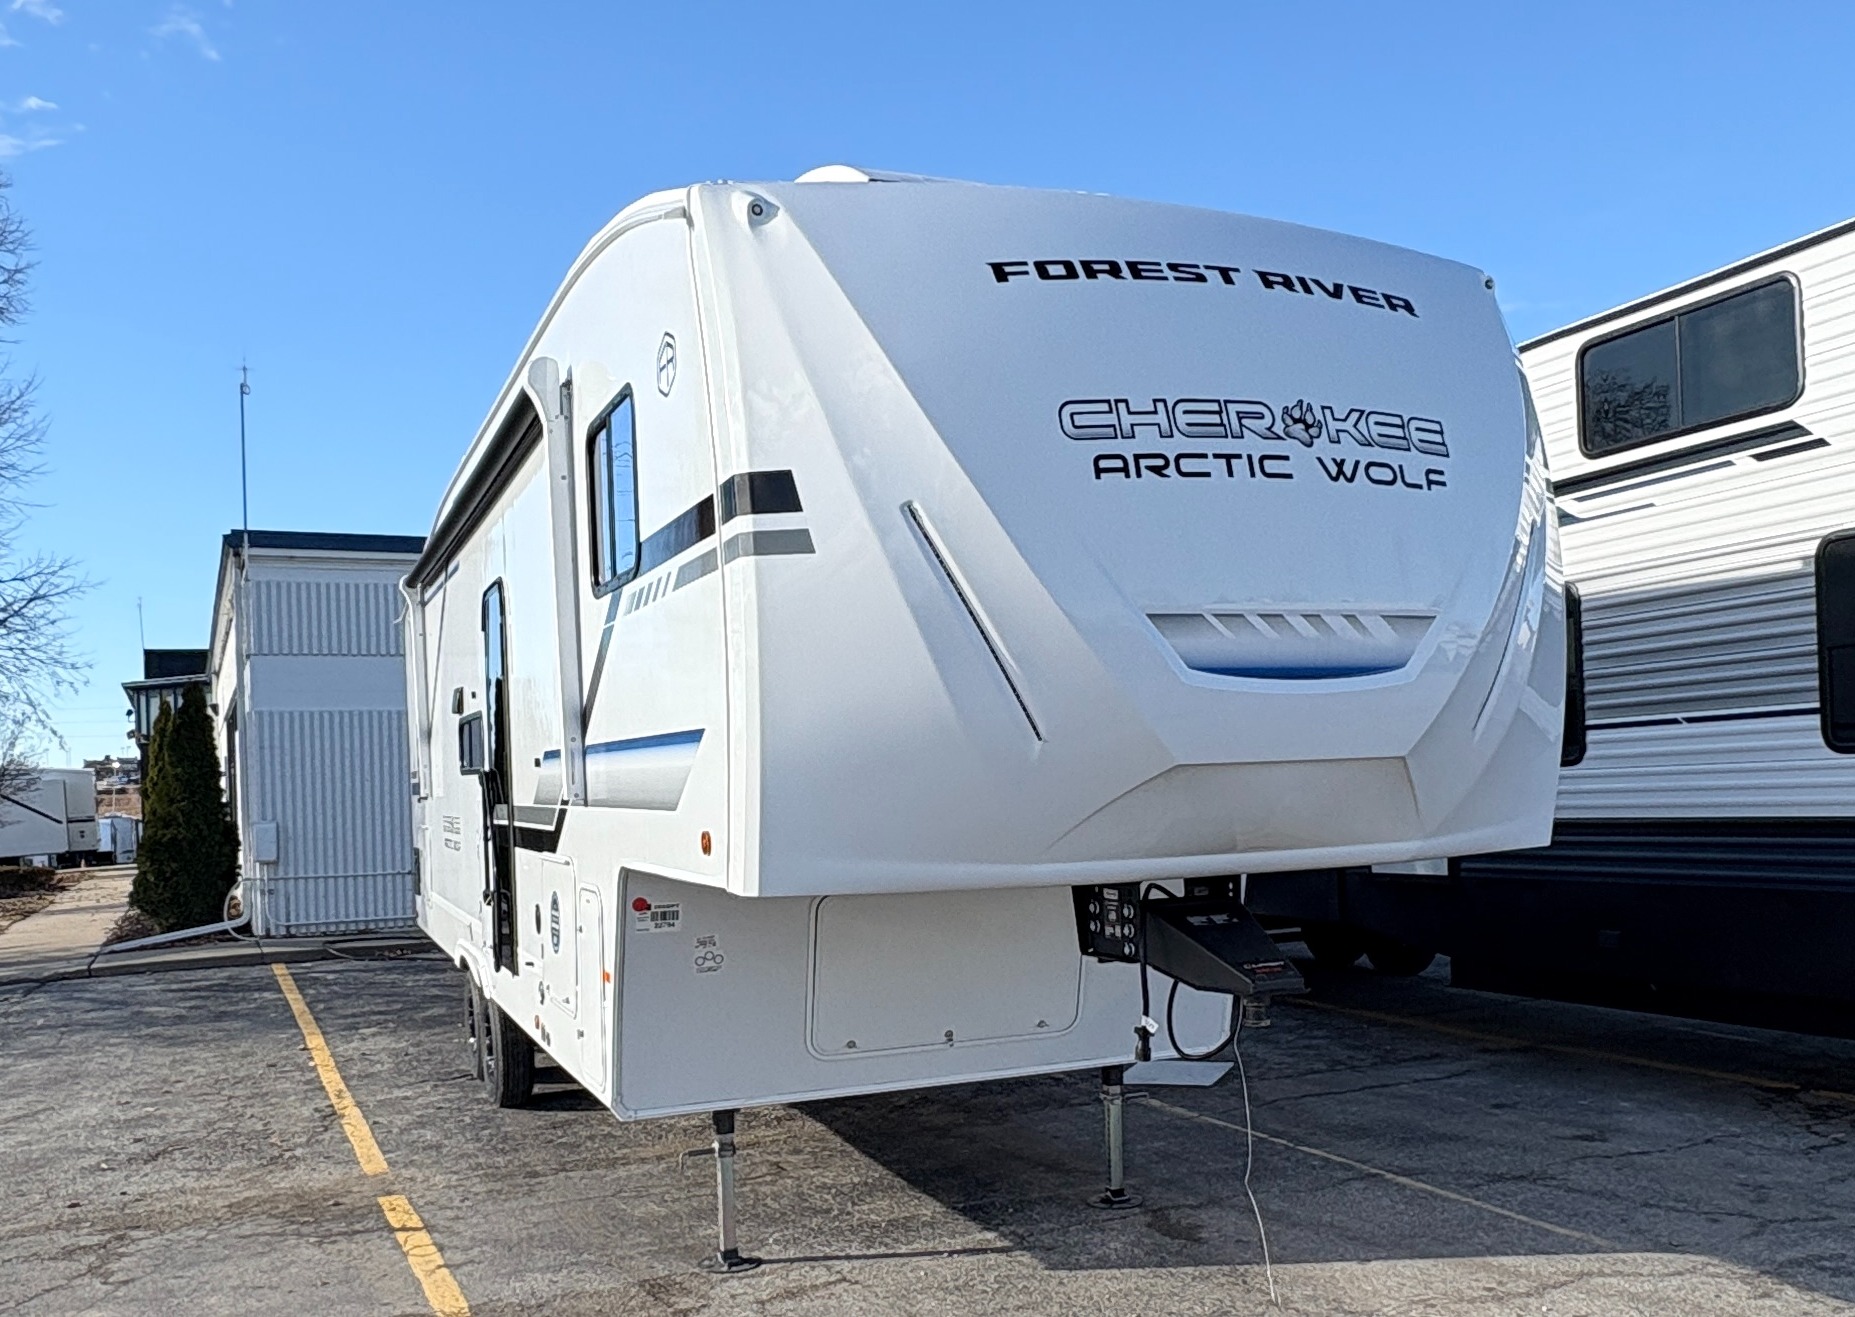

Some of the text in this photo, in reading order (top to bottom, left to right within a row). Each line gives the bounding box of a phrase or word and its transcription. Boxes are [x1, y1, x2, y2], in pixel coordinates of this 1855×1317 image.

[986, 260, 1419, 318] FOREST RIVER
[1093, 452, 1448, 491] ARCTIC WOLF
